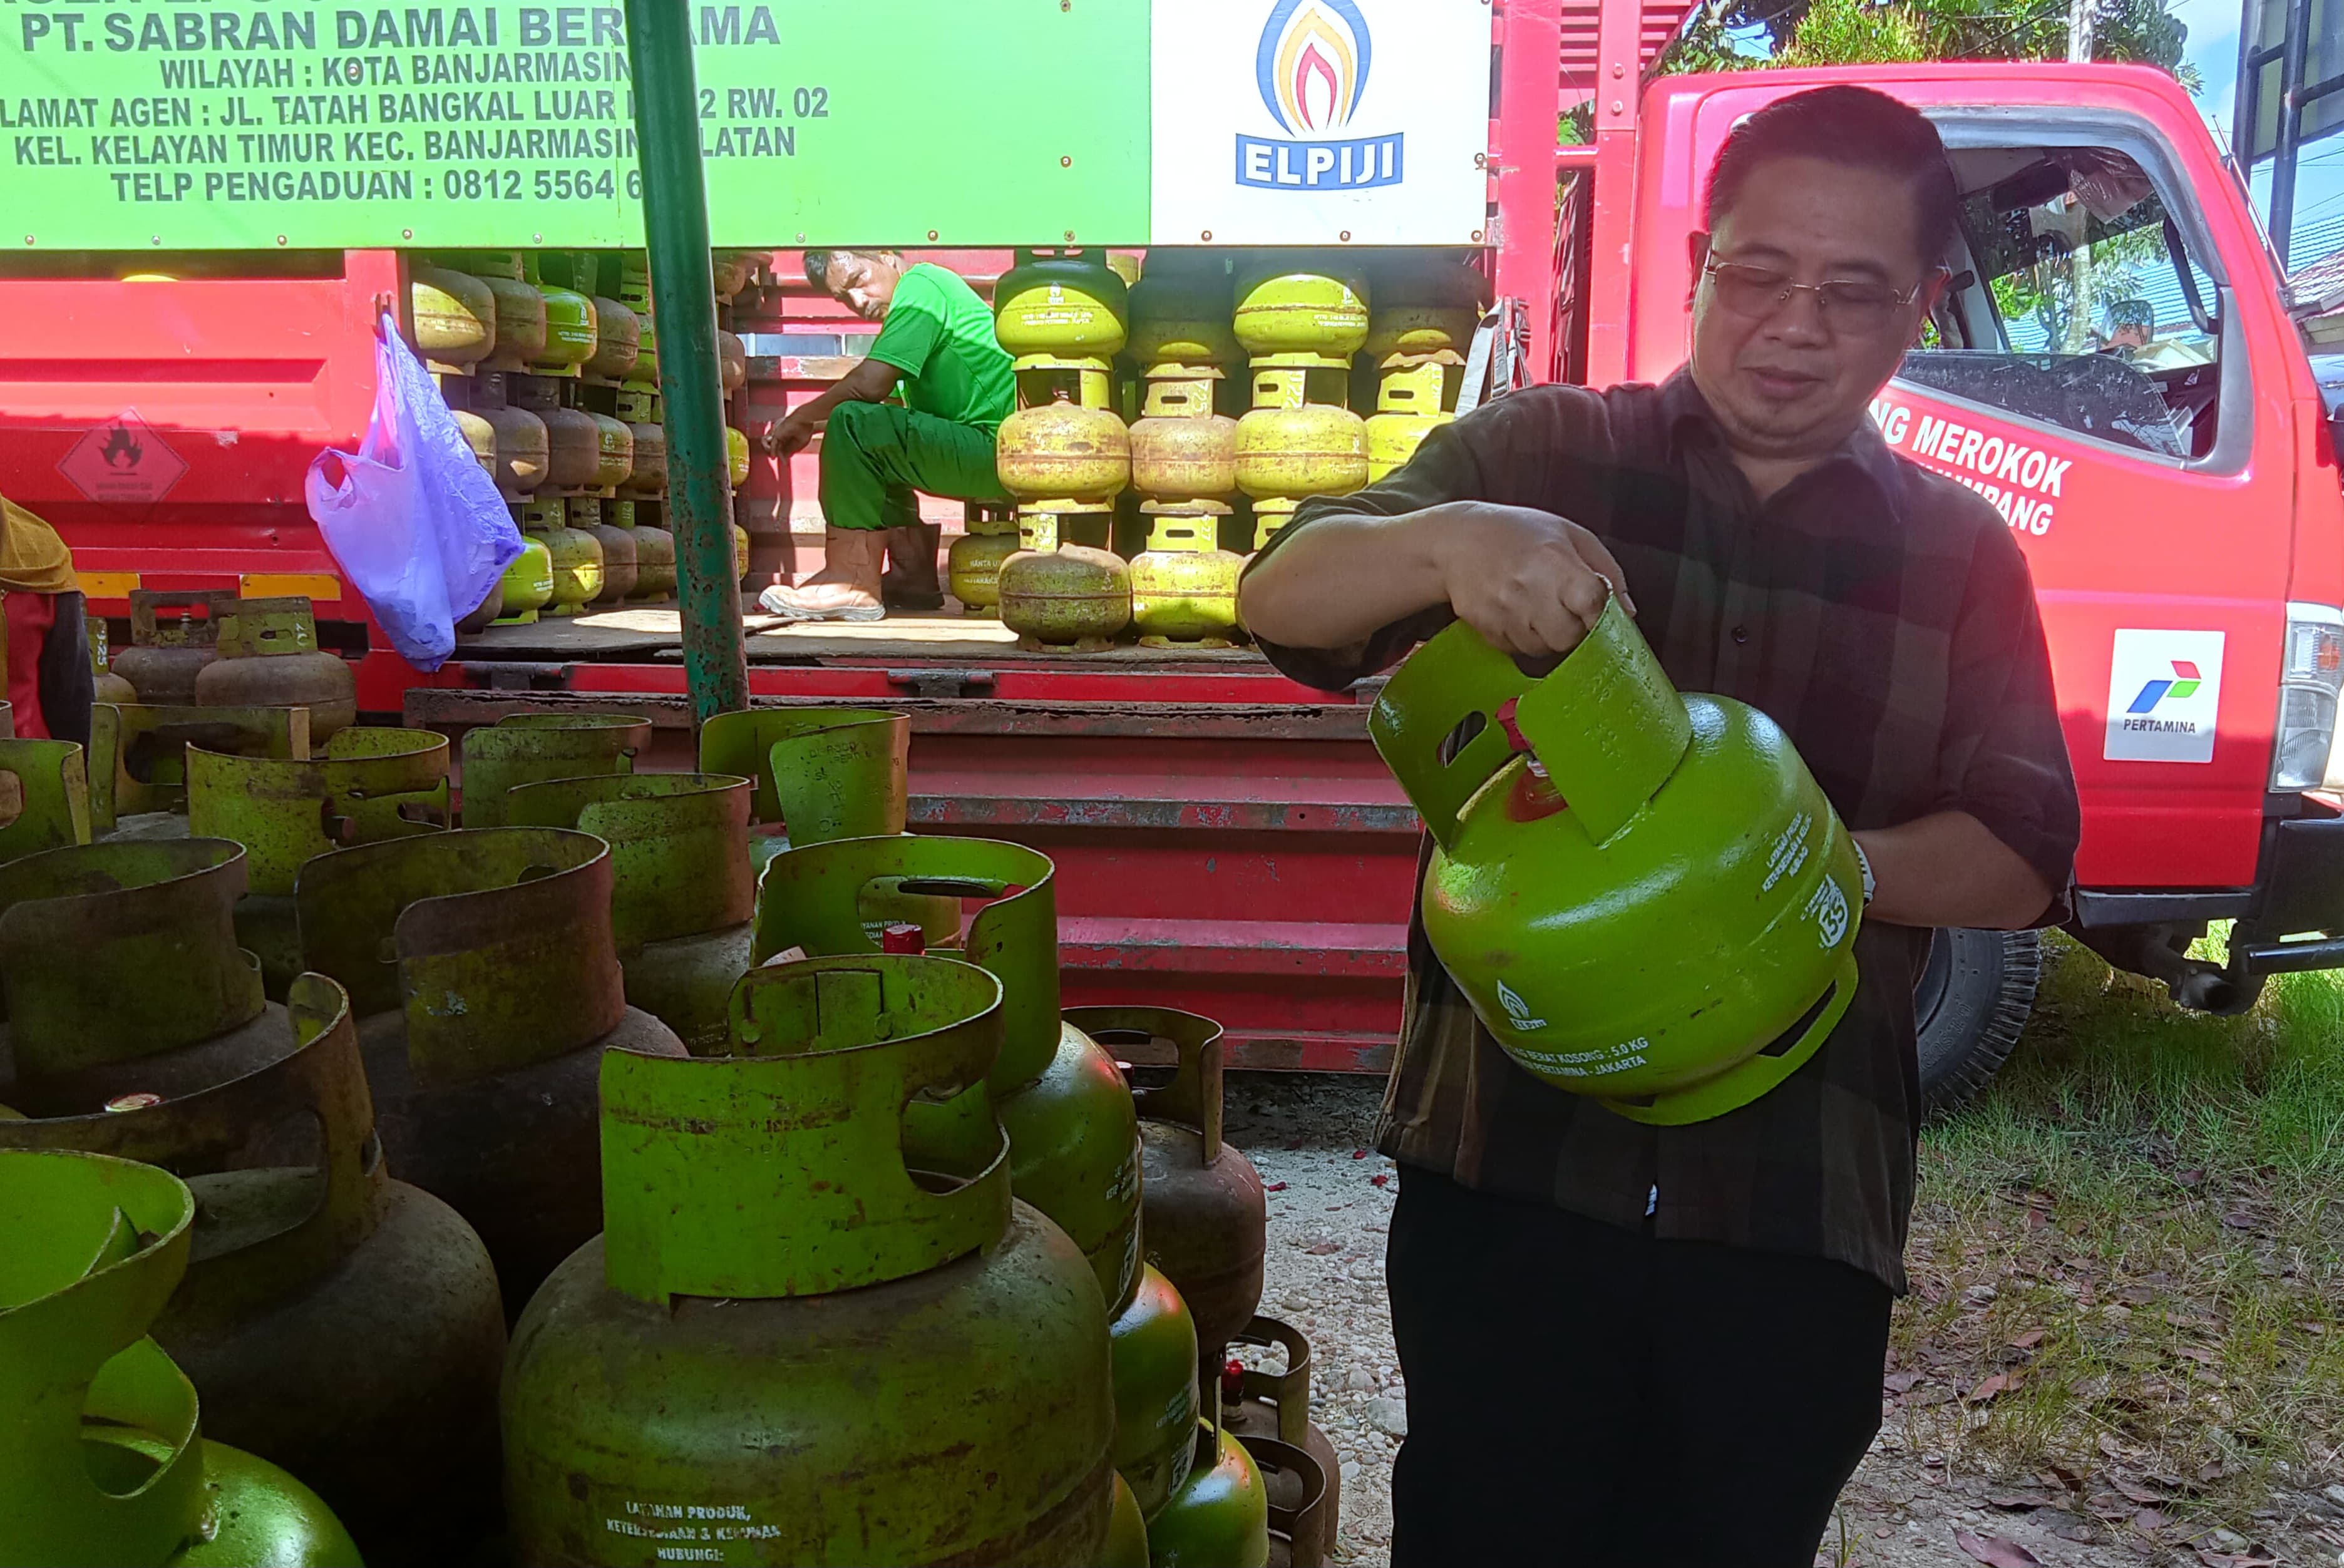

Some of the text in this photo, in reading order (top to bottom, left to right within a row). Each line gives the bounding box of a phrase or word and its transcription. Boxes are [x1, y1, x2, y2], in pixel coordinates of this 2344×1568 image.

[21, 6, 781, 51] PT. SABRAN DAMAI BERMA
[160, 58, 294, 88] WILAYAH
[322, 56, 402, 86] KOTA
[411, 51, 632, 85] BANJARMASIN
[0, 98, 98, 128] LAMAT
[110, 98, 189, 126] AGEN
[220, 96, 263, 126] JL.
[272, 95, 368, 125] TATAH
[379, 92, 524, 123] BANGKAL
[534, 90, 615, 121] LUAR
[728, 88, 783, 118] RW.
[793, 87, 828, 117] 02
[14, 126, 796, 165] KEL. KELAYAN TIMUR KEC. BANJARMASIN LATAN
[1245, 141, 1394, 185] ELPIJI
[110, 172, 193, 202] TELP
[205, 170, 412, 201] PENGADUAN
[443, 168, 522, 200] 0812
[534, 169, 614, 199] 5564
[1911, 415, 2073, 498] MEROKOK
[2123, 718, 2196, 734] PERTAMINA
[1558, 1048, 1604, 1064] KOSONG
[1628, 1036, 1649, 1052] KG
[1594, 1054, 1648, 1076] JAKARTA
